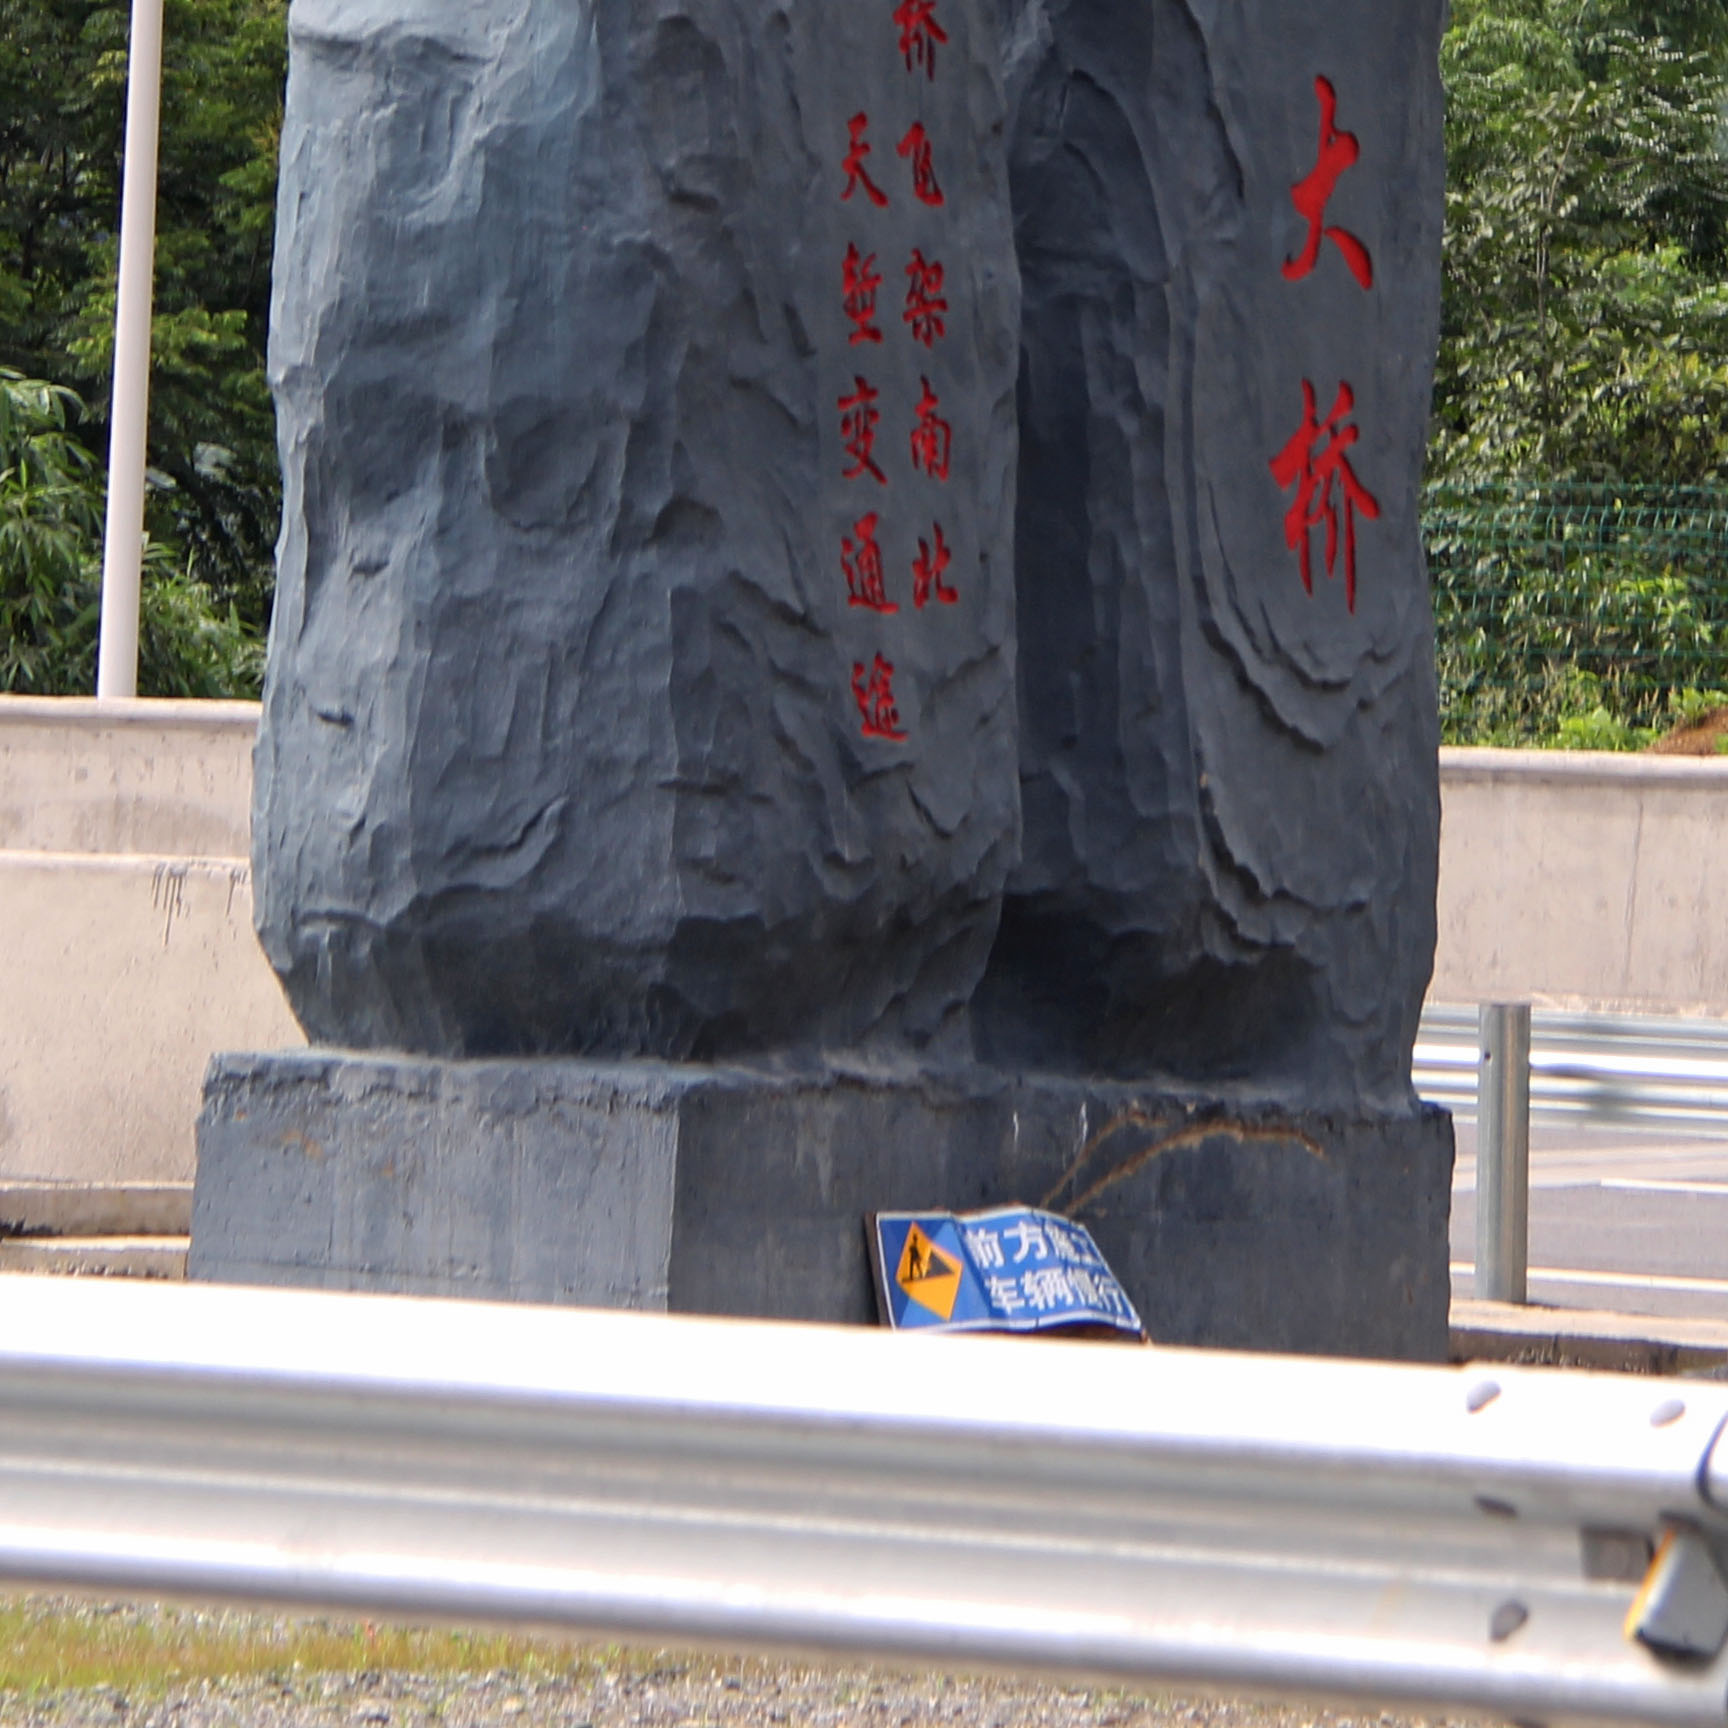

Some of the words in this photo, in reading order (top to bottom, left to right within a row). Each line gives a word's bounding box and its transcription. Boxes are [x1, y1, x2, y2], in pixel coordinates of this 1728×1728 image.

[965, 1218, 1101, 1268] 前方施工
[984, 1266, 1124, 1315] 车辆慢行
